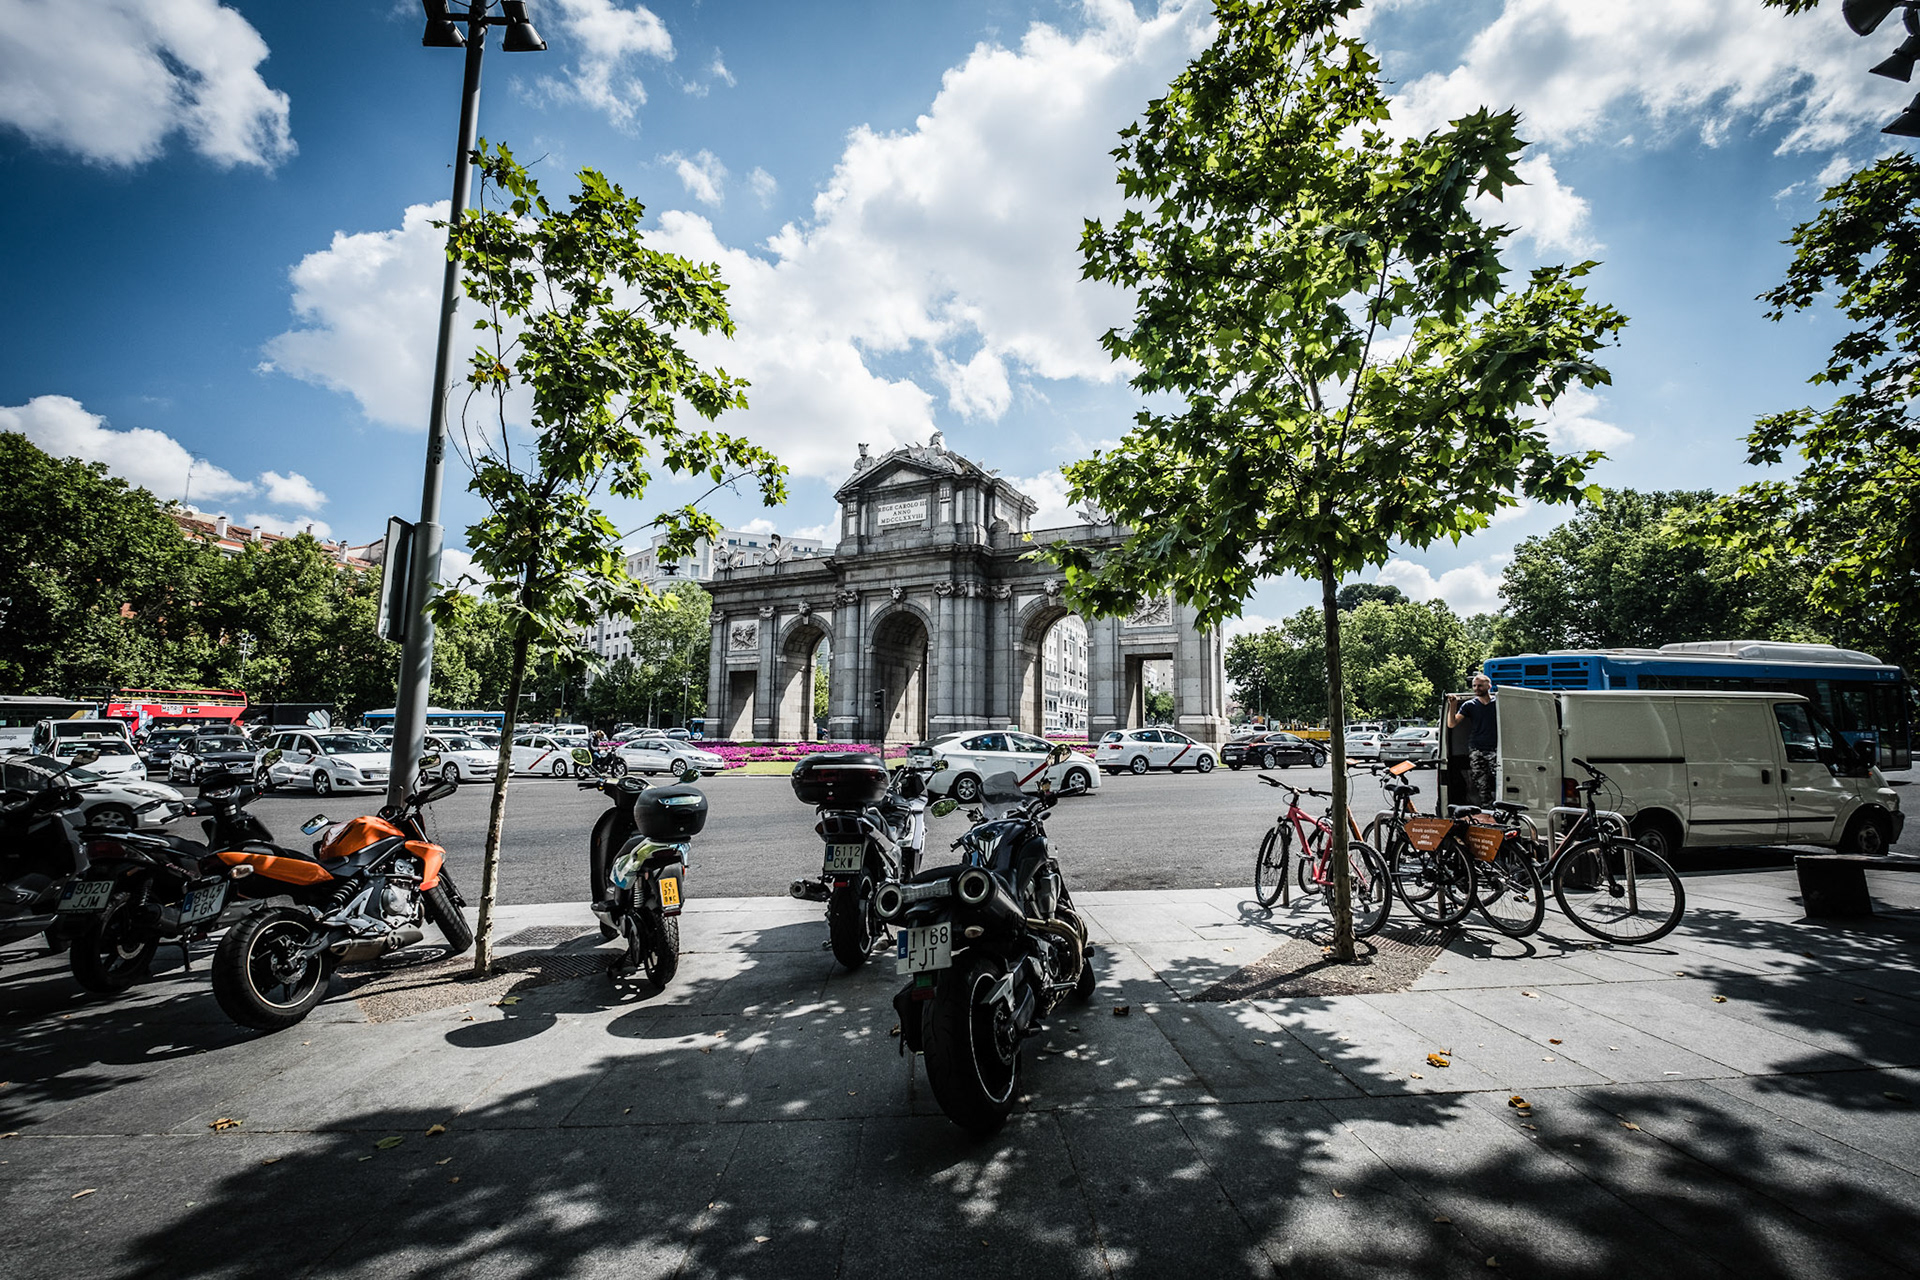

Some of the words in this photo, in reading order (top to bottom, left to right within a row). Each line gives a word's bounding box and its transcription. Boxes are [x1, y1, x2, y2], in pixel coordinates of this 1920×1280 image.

[894, 502, 919, 510] CAROLO
[834, 846, 861, 857] 6112
[75, 883, 110, 895] 9020
[72, 897, 100, 908] JJM
[191, 898, 216, 918] FGK
[912, 926, 949, 949] 1168
[908, 946, 938, 970] FJT
